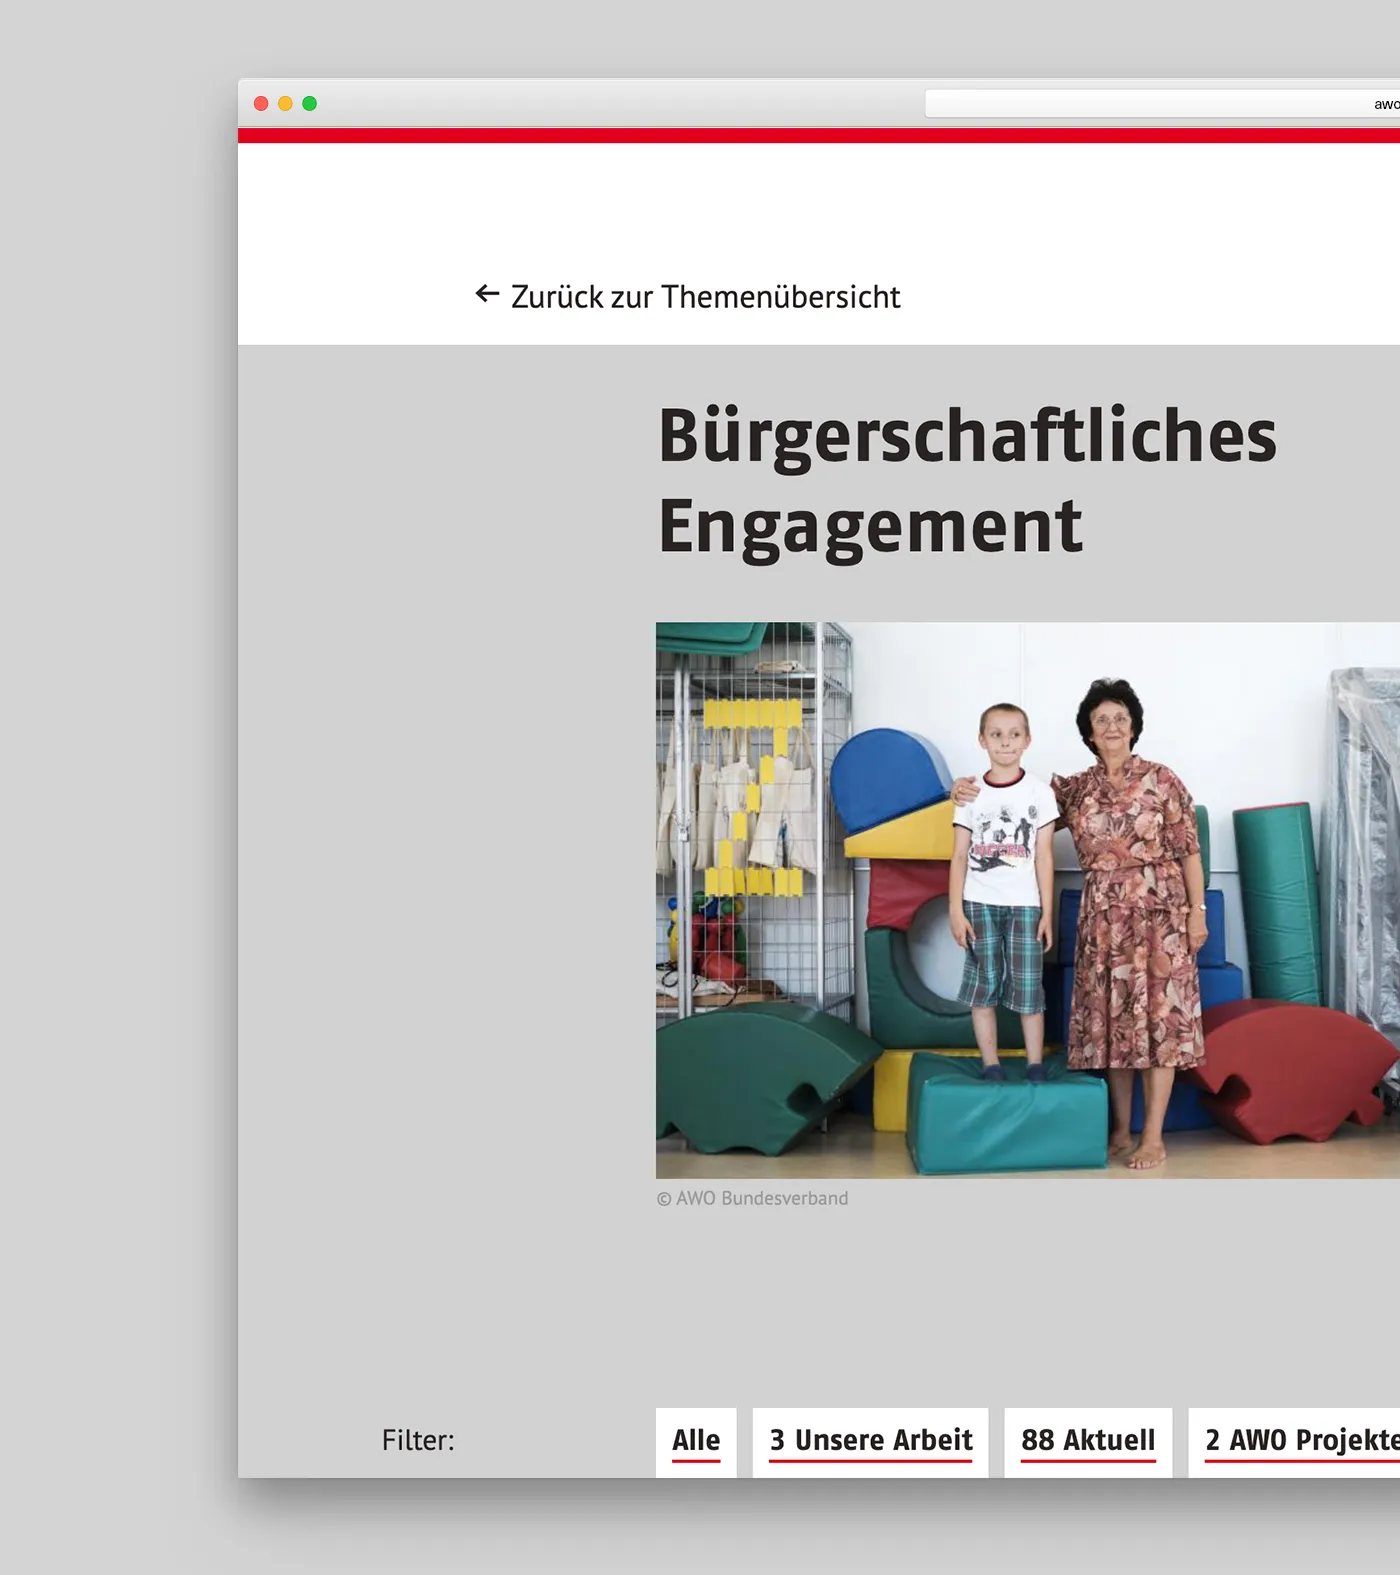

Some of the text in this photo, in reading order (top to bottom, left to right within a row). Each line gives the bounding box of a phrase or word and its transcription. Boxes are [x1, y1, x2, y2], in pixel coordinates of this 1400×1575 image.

[512, 284, 901, 308] Zurück zur Themenübersicht
[662, 403, 1277, 476] Bürgerschaftliches
[662, 499, 1084, 566] Engagement
[676, 1191, 716, 1206] AWO
[722, 1191, 849, 1206] Bundesverband
[384, 1429, 453, 1451] Filter:
[672, 1429, 720, 1450] Alle
[771, 1427, 973, 1450] 3 Unsere Arbeit
[1022, 1429, 1154, 1450] 88 Aktuell
[1207, 1429, 1219, 1450] 2
[1230, 1429, 1286, 1450] AWO
